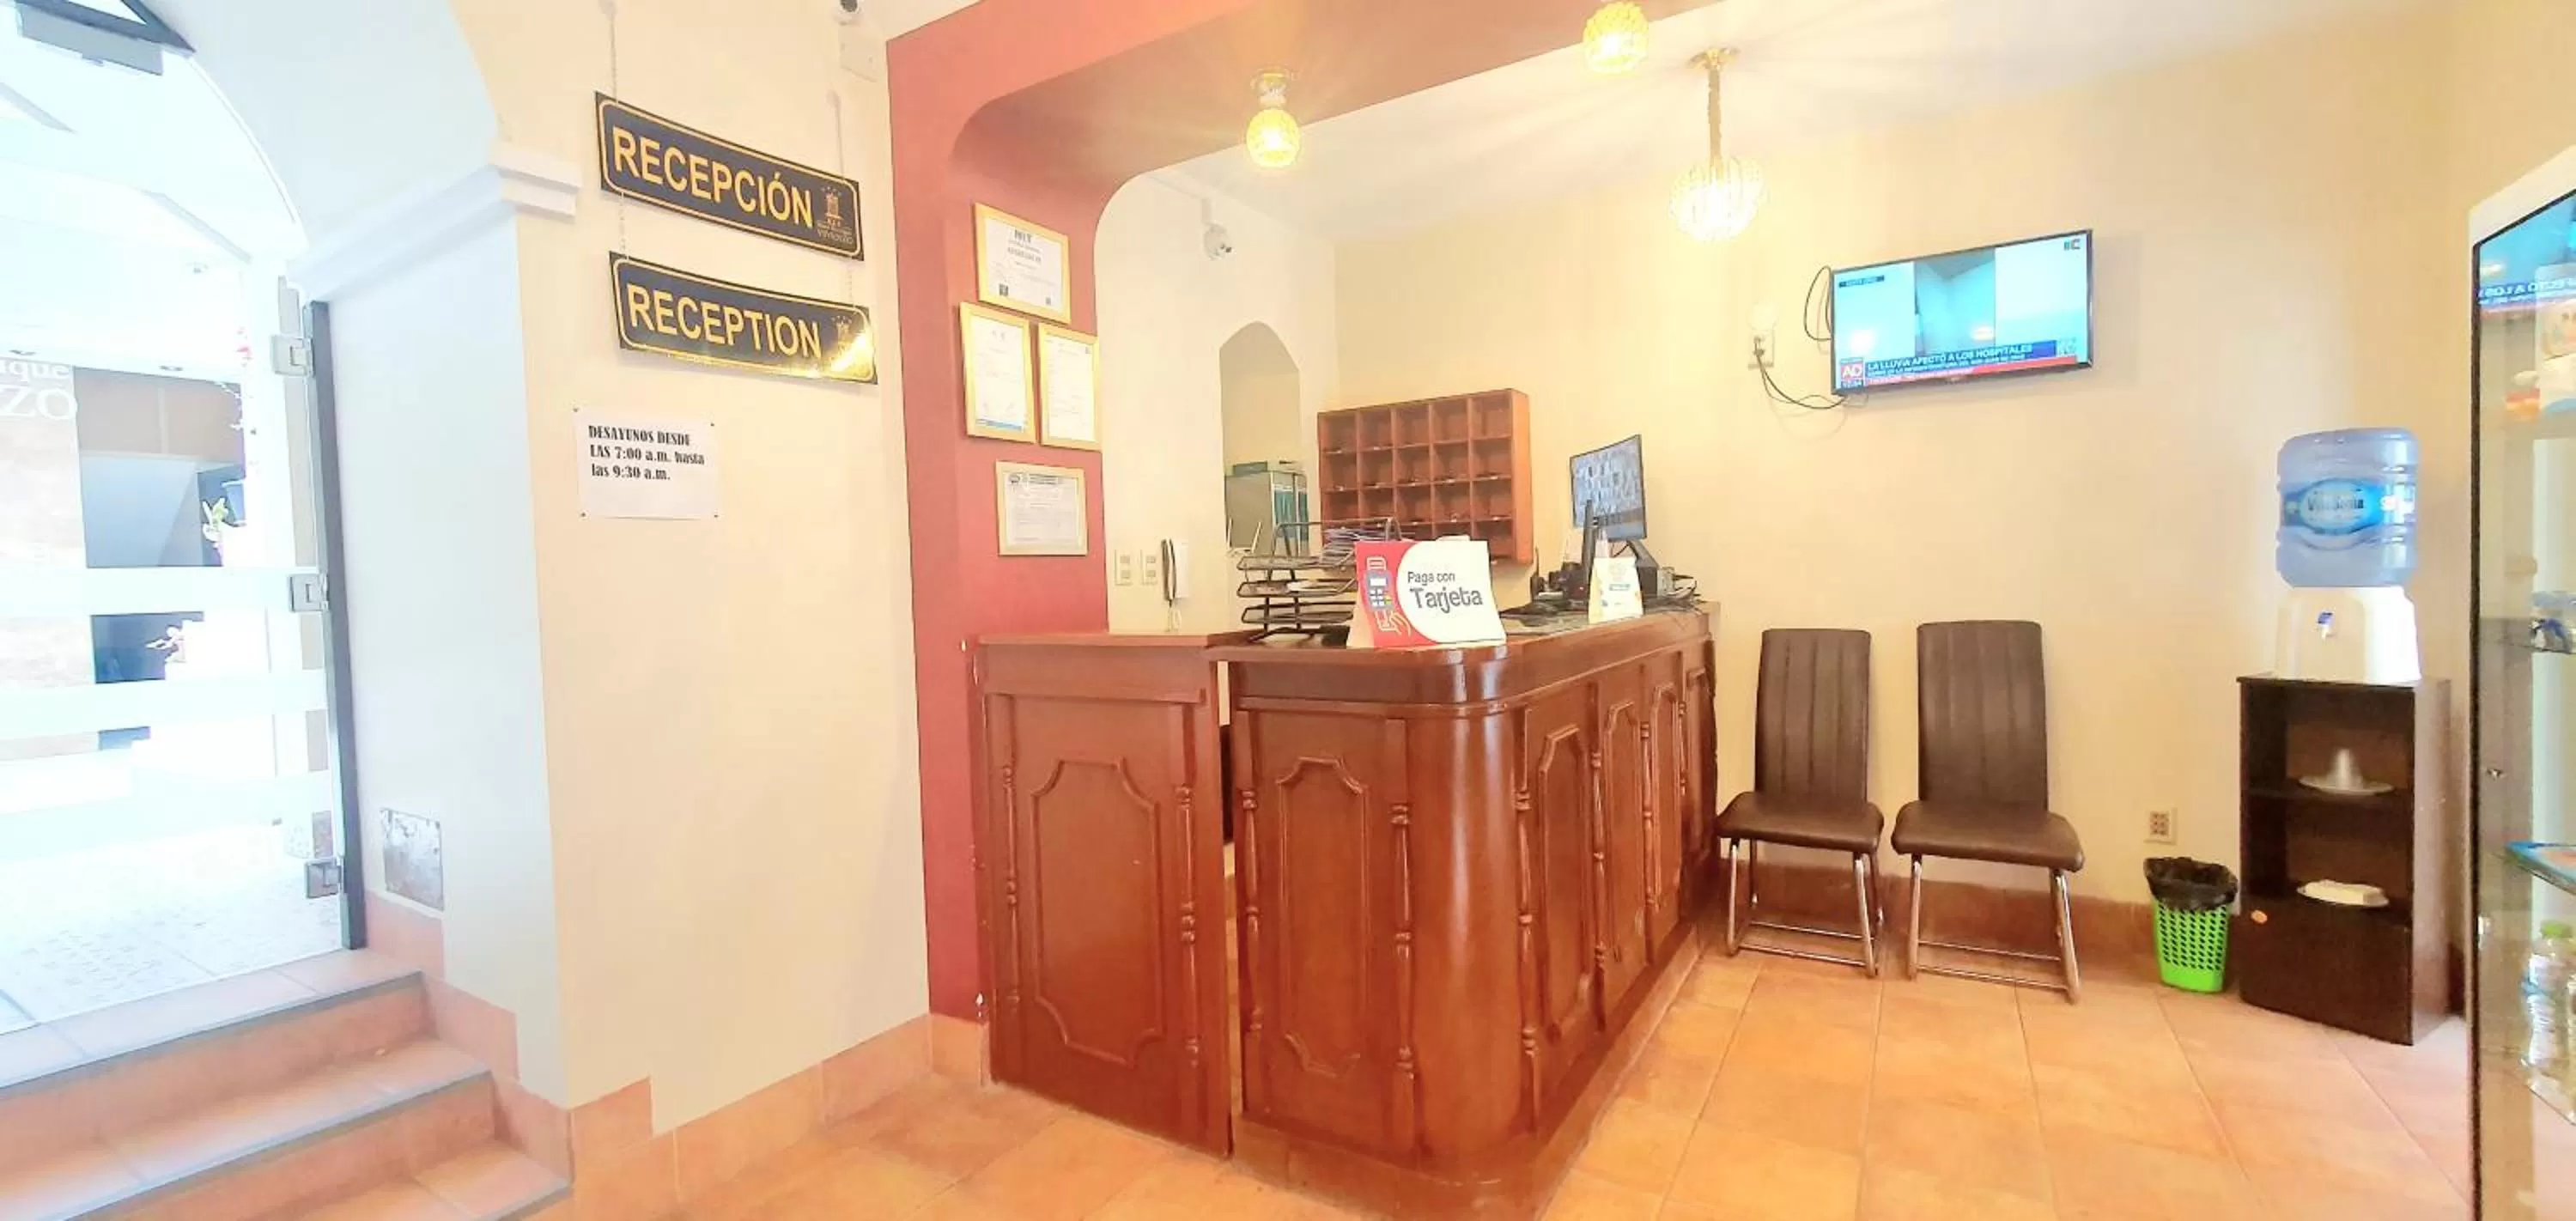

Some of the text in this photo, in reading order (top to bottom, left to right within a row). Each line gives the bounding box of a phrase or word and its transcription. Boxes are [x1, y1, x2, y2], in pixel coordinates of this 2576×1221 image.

[612, 125, 812, 228] RECEPCIÓN
[627, 282, 821, 358] RECEPTION
[588, 425, 690, 446] DESAYUNOS DESDE
[590, 444, 705, 465] LAS 7:00 a.m. hasta
[592, 464, 671, 480] las 9:30 a.m.
[1407, 571, 1455, 586] Paga con
[1409, 586, 1483, 613] Tarjeta
